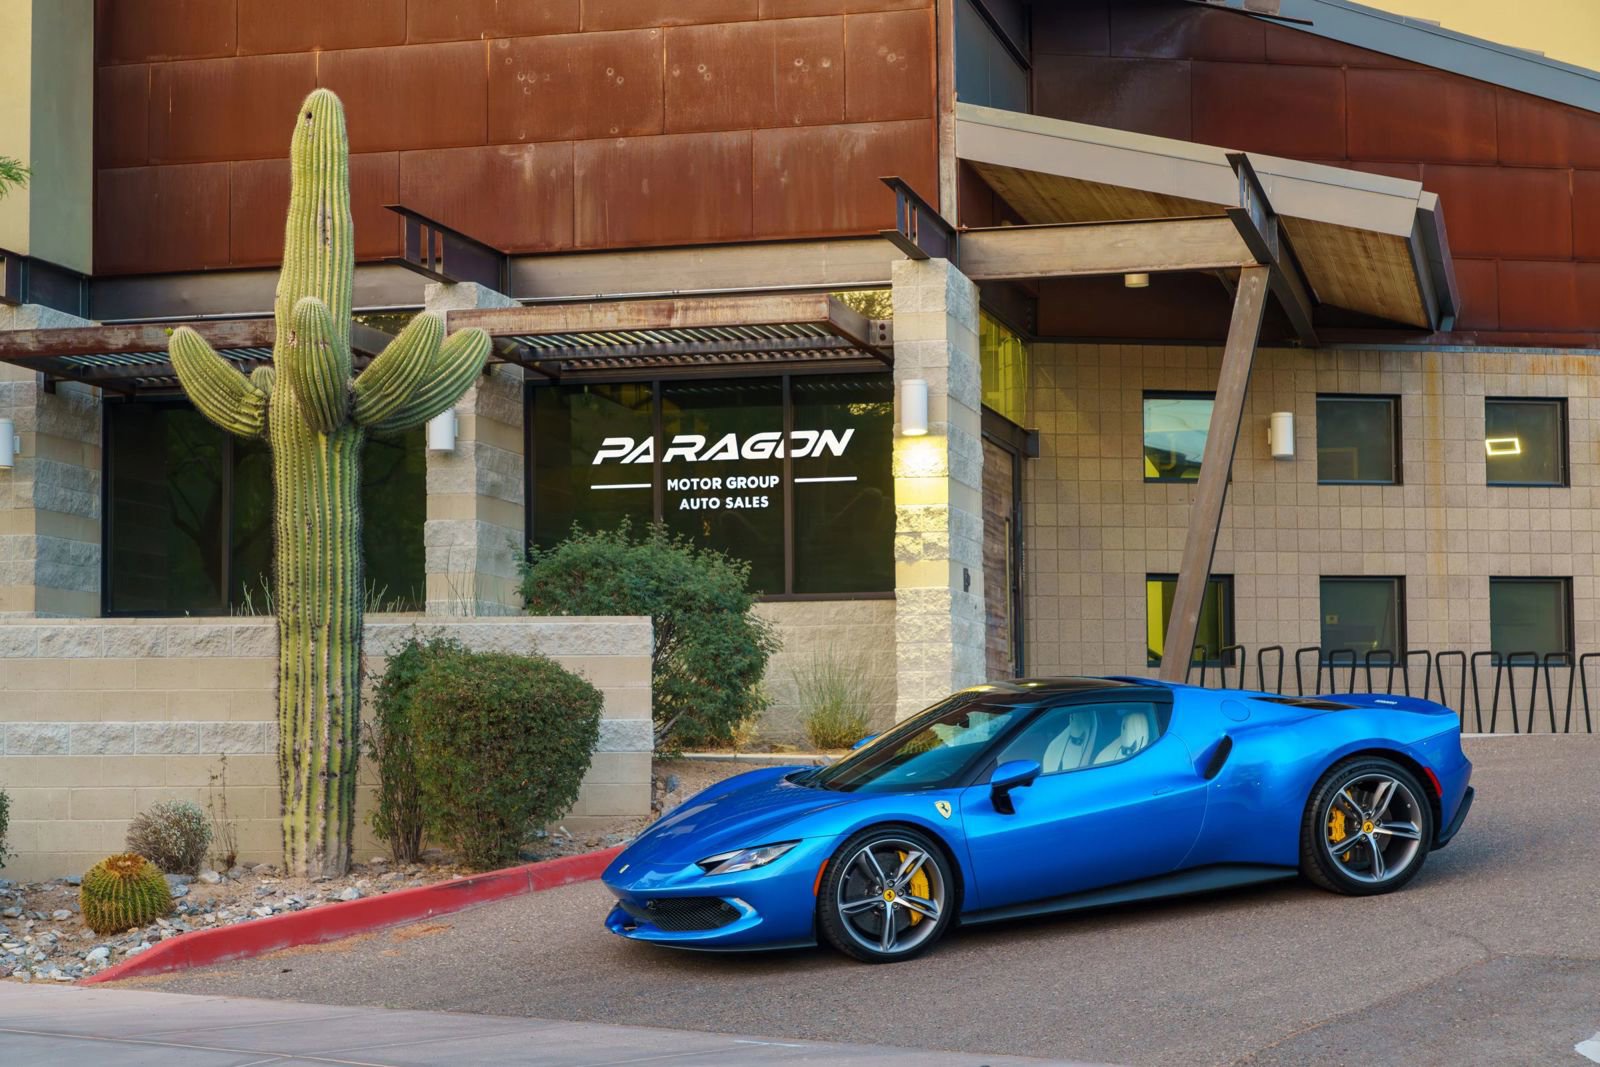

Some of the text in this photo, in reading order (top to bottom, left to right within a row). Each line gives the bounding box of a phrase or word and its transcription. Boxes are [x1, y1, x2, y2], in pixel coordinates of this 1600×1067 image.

[592, 428, 855, 465] PARAGON
[667, 475, 780, 491] MOTOR GROUP
[679, 496, 769, 510] AUTO SALES
